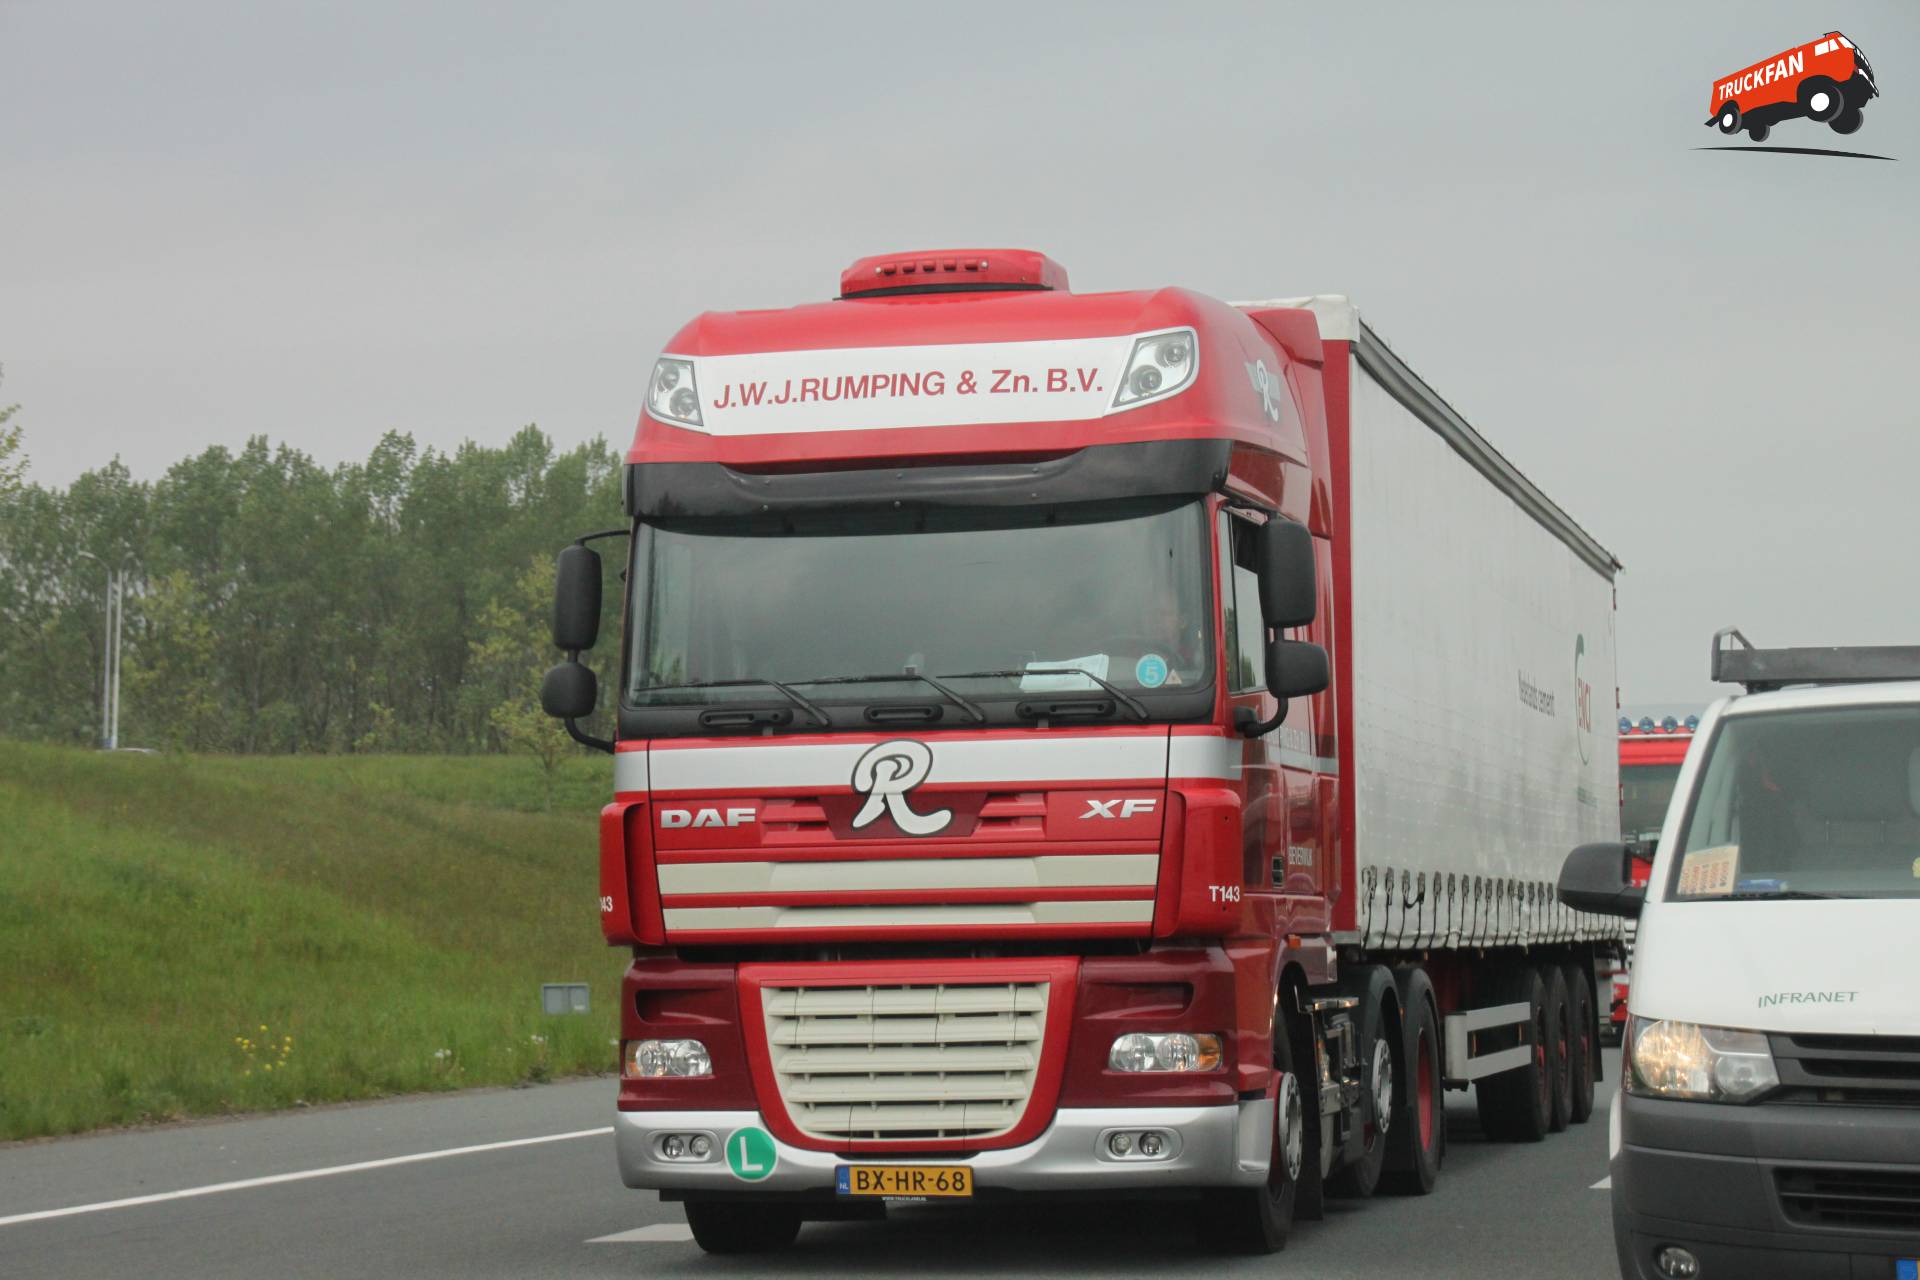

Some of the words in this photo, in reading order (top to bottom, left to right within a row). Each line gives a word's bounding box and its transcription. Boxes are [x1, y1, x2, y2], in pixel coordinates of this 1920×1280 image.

[713, 371, 945, 409] J.W.J.RUMPING
[956, 370, 978, 395] &
[990, 369, 1038, 394] Zn.
[1047, 368, 1104, 393] B.V.
[1145, 665, 1160, 683] 5
[660, 807, 757, 829] DAF
[1078, 798, 1157, 820] XF
[1208, 885, 1241, 903] T143
[1758, 991, 1859, 1009] INFRANET
[739, 1135, 764, 1172] L
[840, 1182, 849, 1190] NL
[856, 1170, 965, 1192] BX-HR-68
